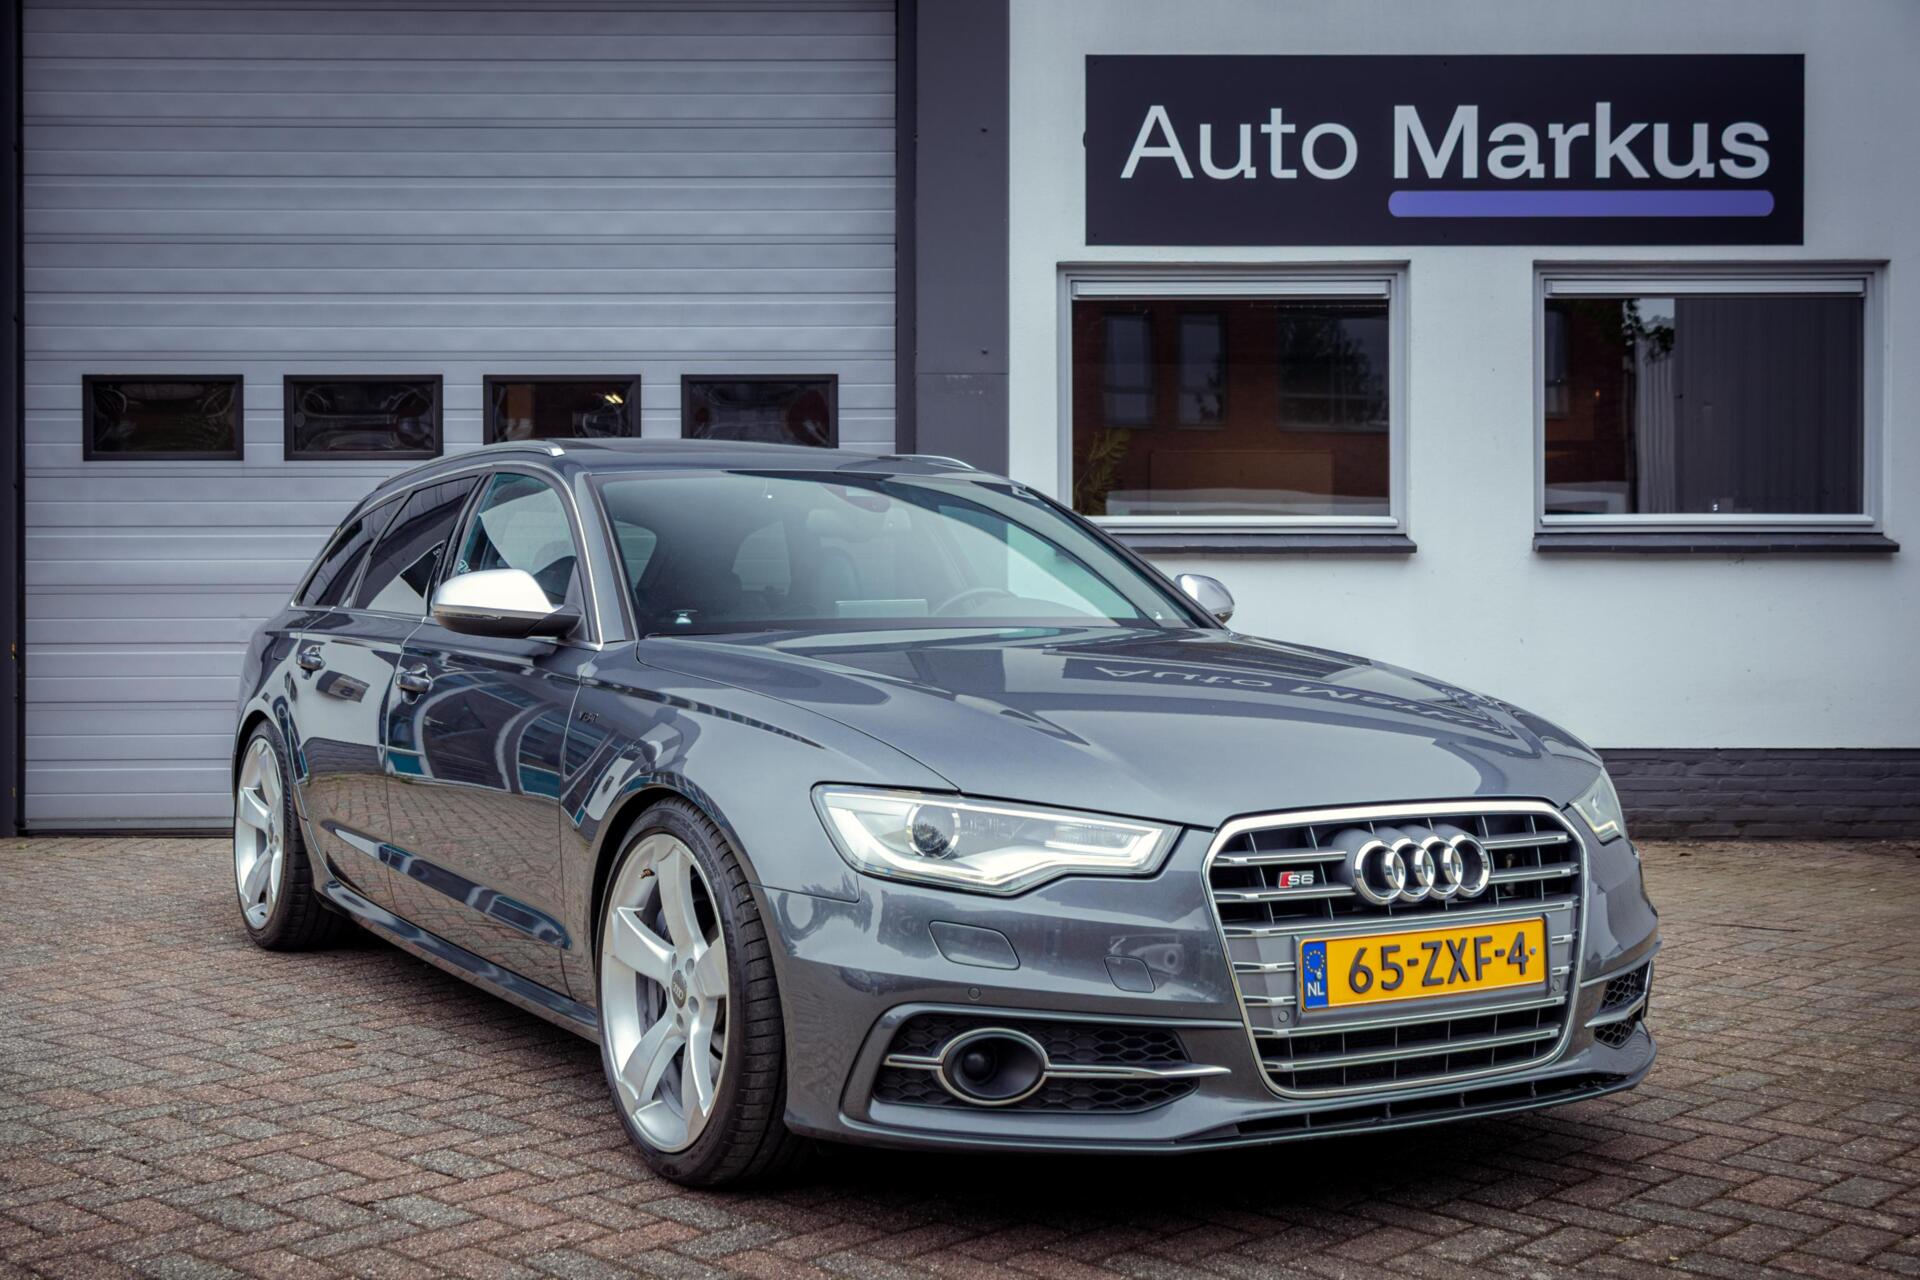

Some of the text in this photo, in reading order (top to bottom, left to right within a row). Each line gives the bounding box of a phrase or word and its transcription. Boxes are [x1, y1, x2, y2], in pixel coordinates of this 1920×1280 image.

[1120, 101, 1770, 180] Auto Markus
[1287, 873, 1314, 886] S6
[1348, 931, 1529, 994] 65-ZXF-4
[1307, 981, 1325, 997] NL
